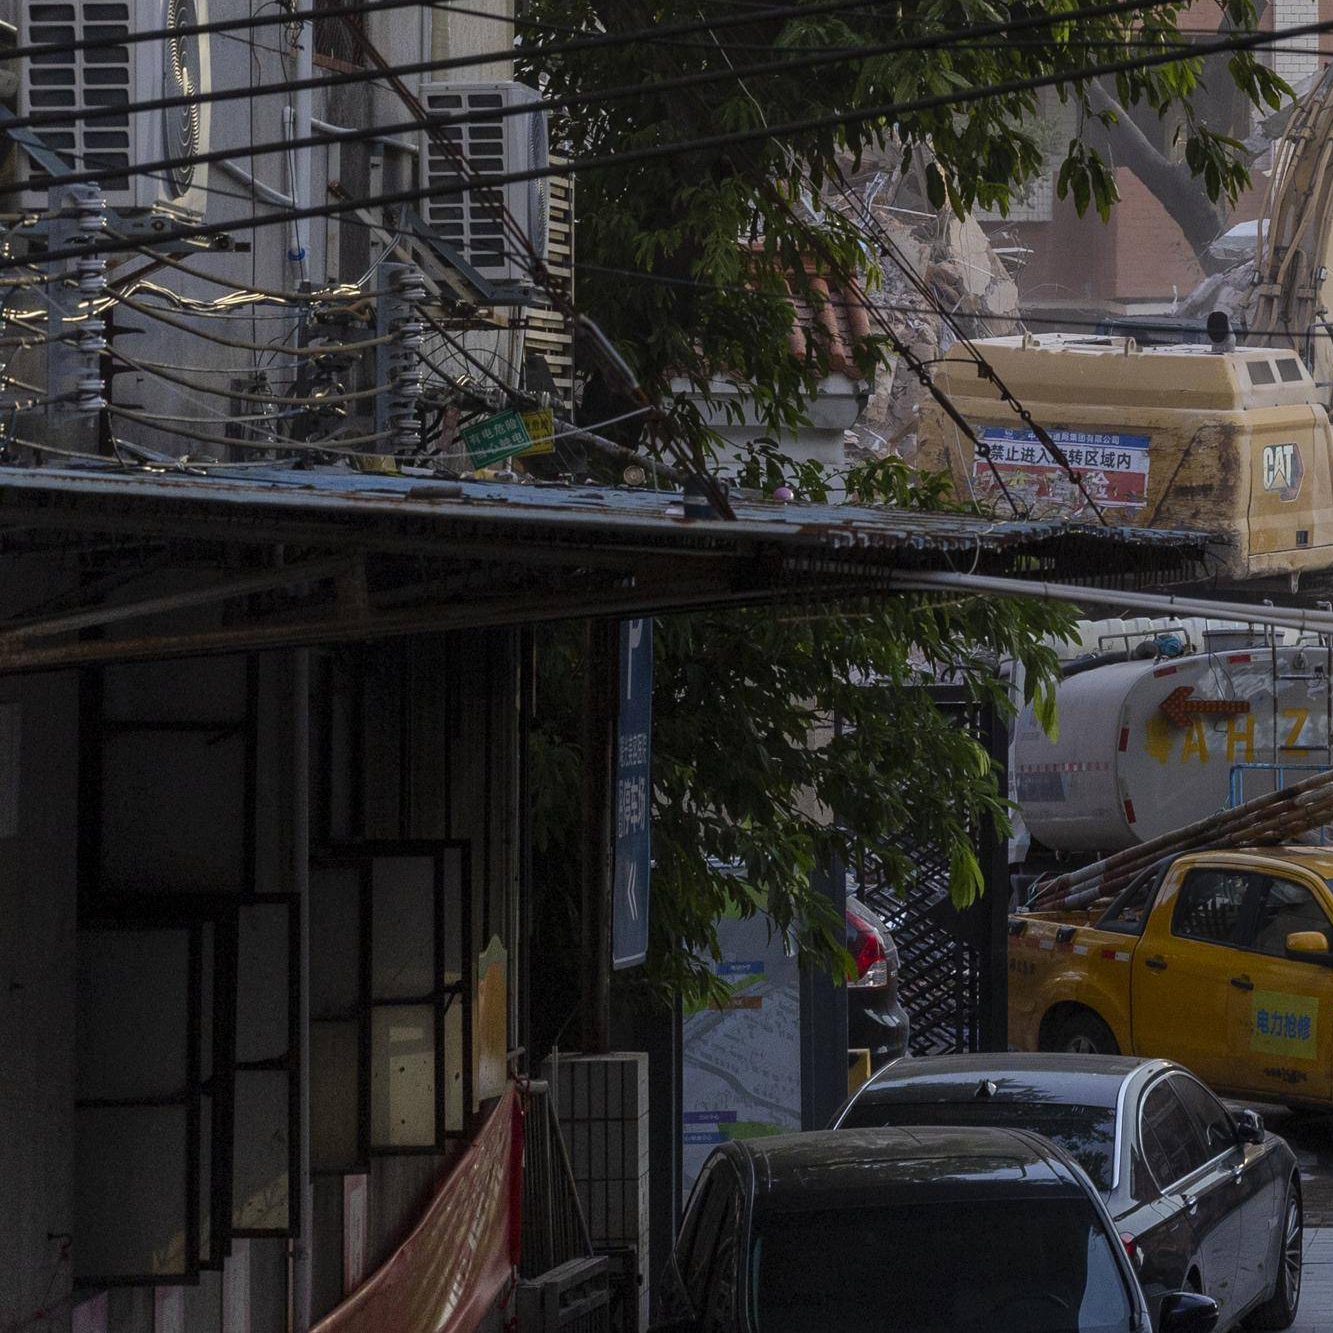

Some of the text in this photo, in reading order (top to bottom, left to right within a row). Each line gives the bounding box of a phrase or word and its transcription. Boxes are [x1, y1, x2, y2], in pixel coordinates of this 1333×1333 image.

[1263, 444, 1293, 489] CAT
[1257, 1009, 1311, 1040] 电力抢修
